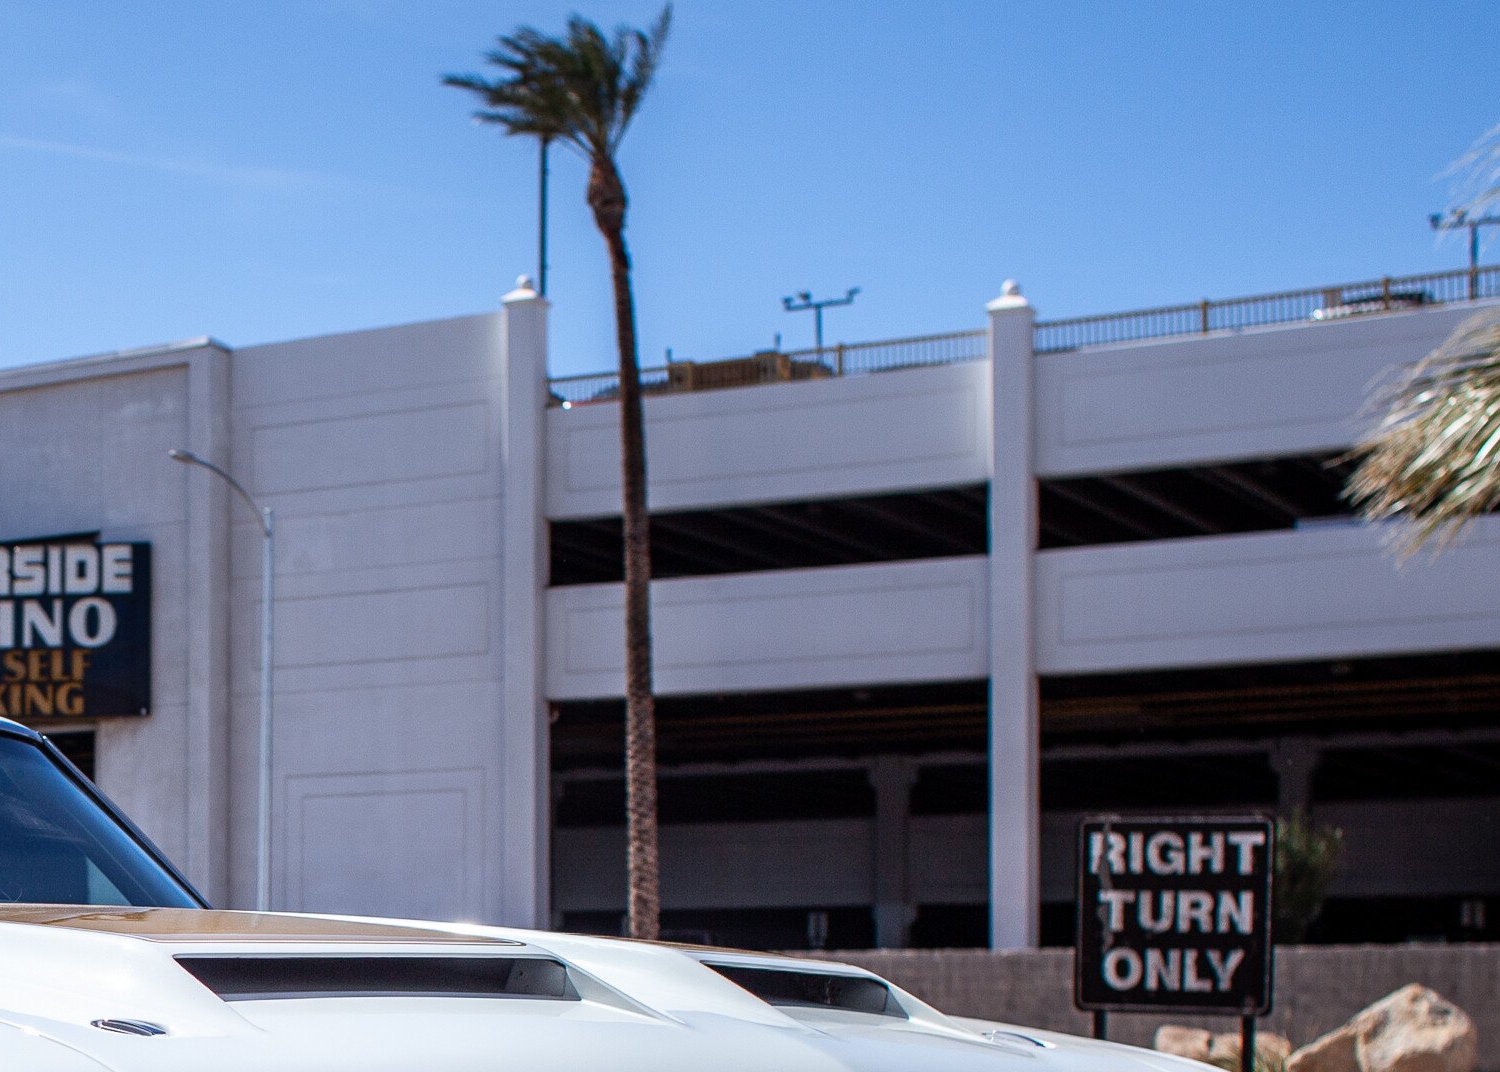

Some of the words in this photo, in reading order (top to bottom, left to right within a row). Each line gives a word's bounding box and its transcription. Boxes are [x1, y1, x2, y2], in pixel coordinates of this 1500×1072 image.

[3, 649, 92, 682] SELF
[1089, 831, 1266, 875] RIGHT
[1099, 889, 1254, 934] TURN
[1103, 947, 1245, 992] ONLY
